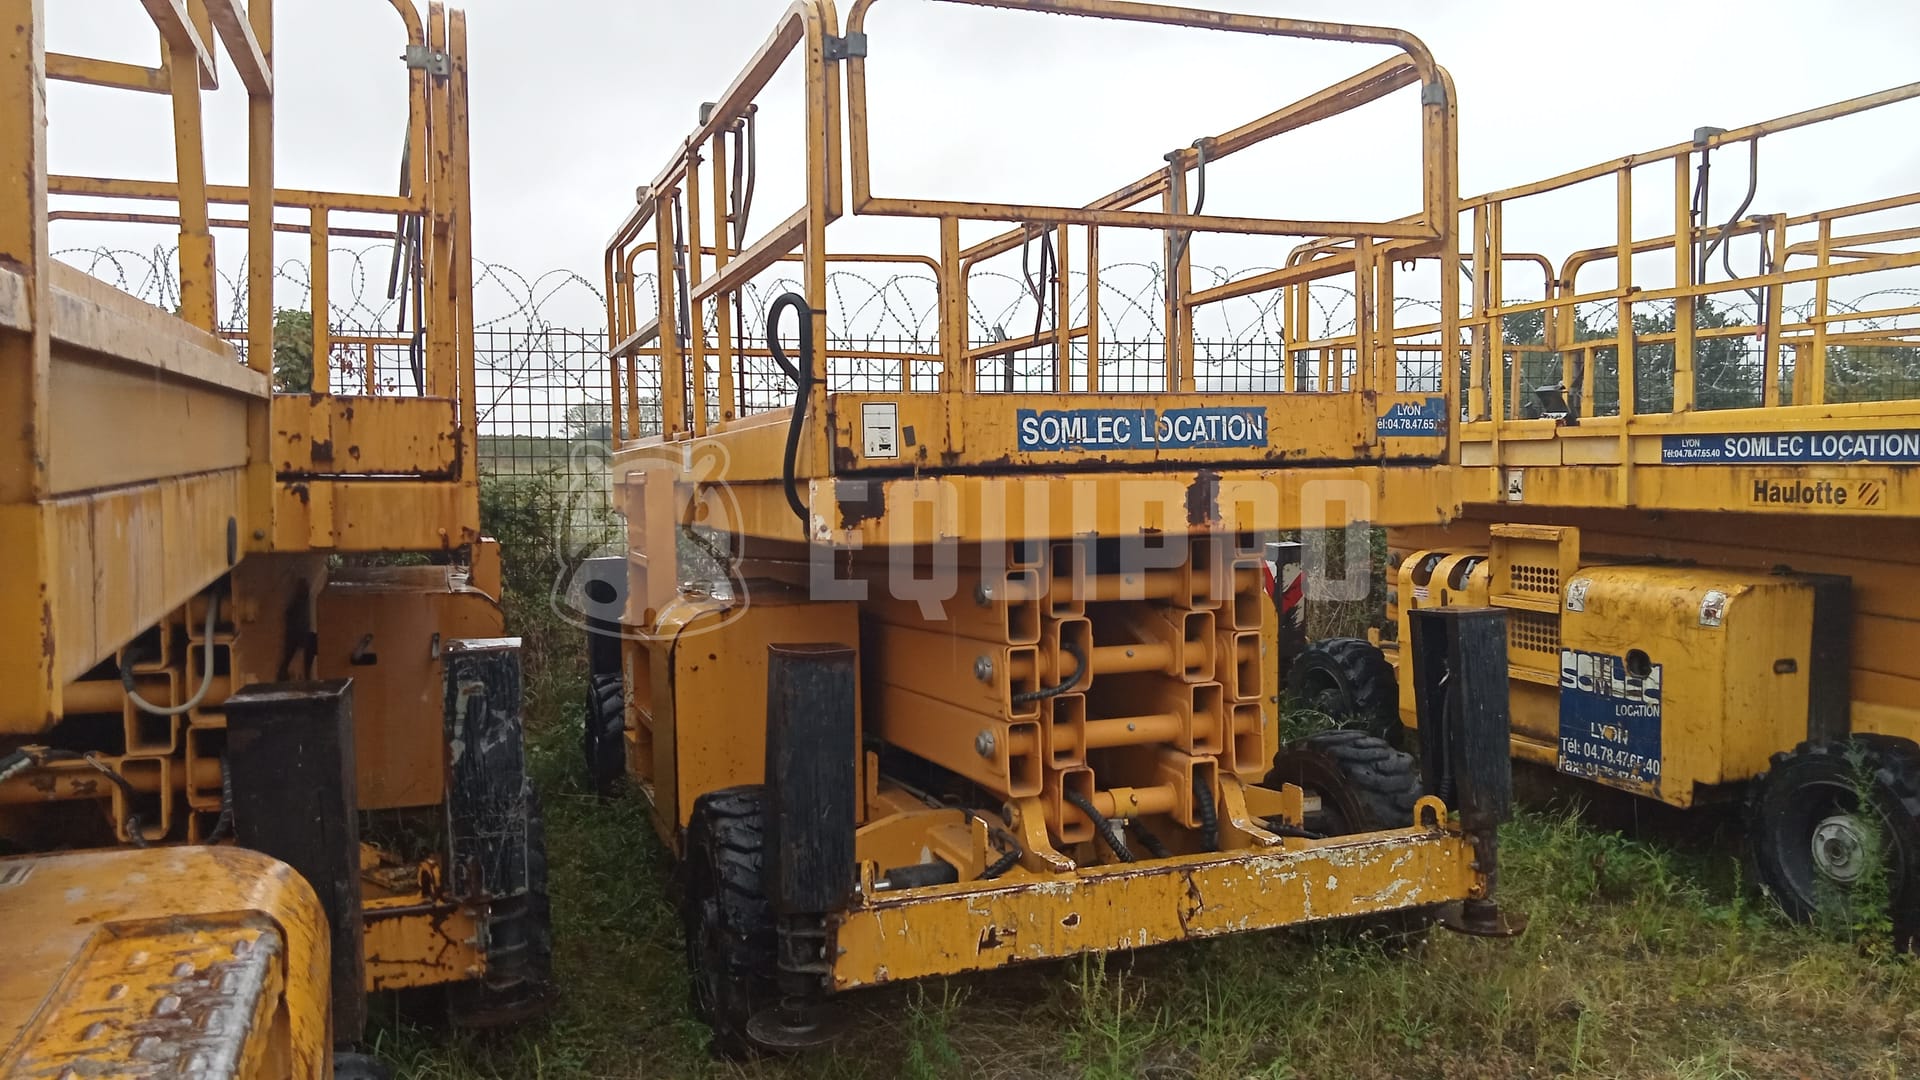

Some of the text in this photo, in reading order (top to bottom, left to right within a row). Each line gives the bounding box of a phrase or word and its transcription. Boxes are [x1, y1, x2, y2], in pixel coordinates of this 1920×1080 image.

[1397, 405, 1421, 416] LYON
[1022, 414, 1264, 445] SOMLEC LOCATION
[1681, 439, 1700, 448] LYON
[1723, 433, 1920, 458] SOMLEC LOCATION
[1753, 479, 1848, 505] Haulotte
[1615, 704, 1660, 717] LOCATION
[1560, 737, 1581, 755] Tél:
